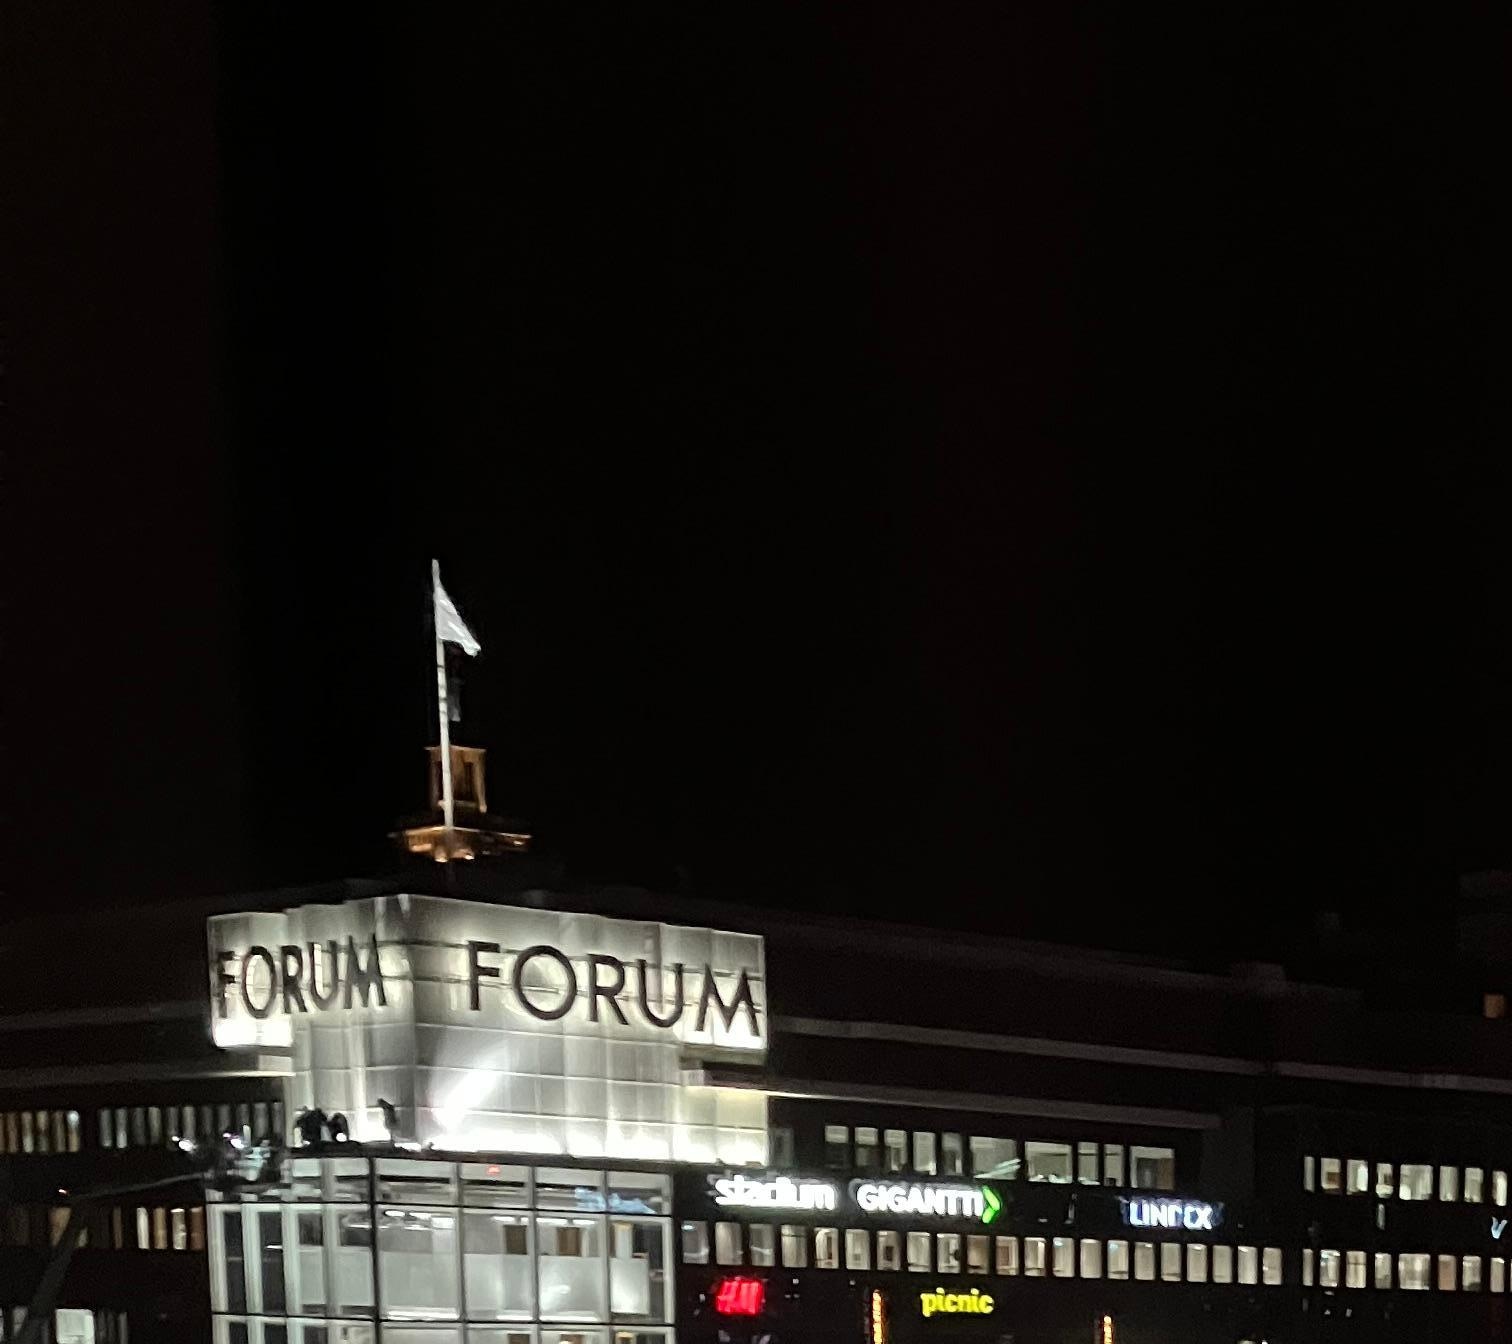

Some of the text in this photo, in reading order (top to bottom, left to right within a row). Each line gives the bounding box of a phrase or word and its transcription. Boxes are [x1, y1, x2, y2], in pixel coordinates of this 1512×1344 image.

[216, 932, 388, 1020] FORUM
[467, 940, 761, 1038] FORUM
[920, 1287, 994, 1317] picnic
